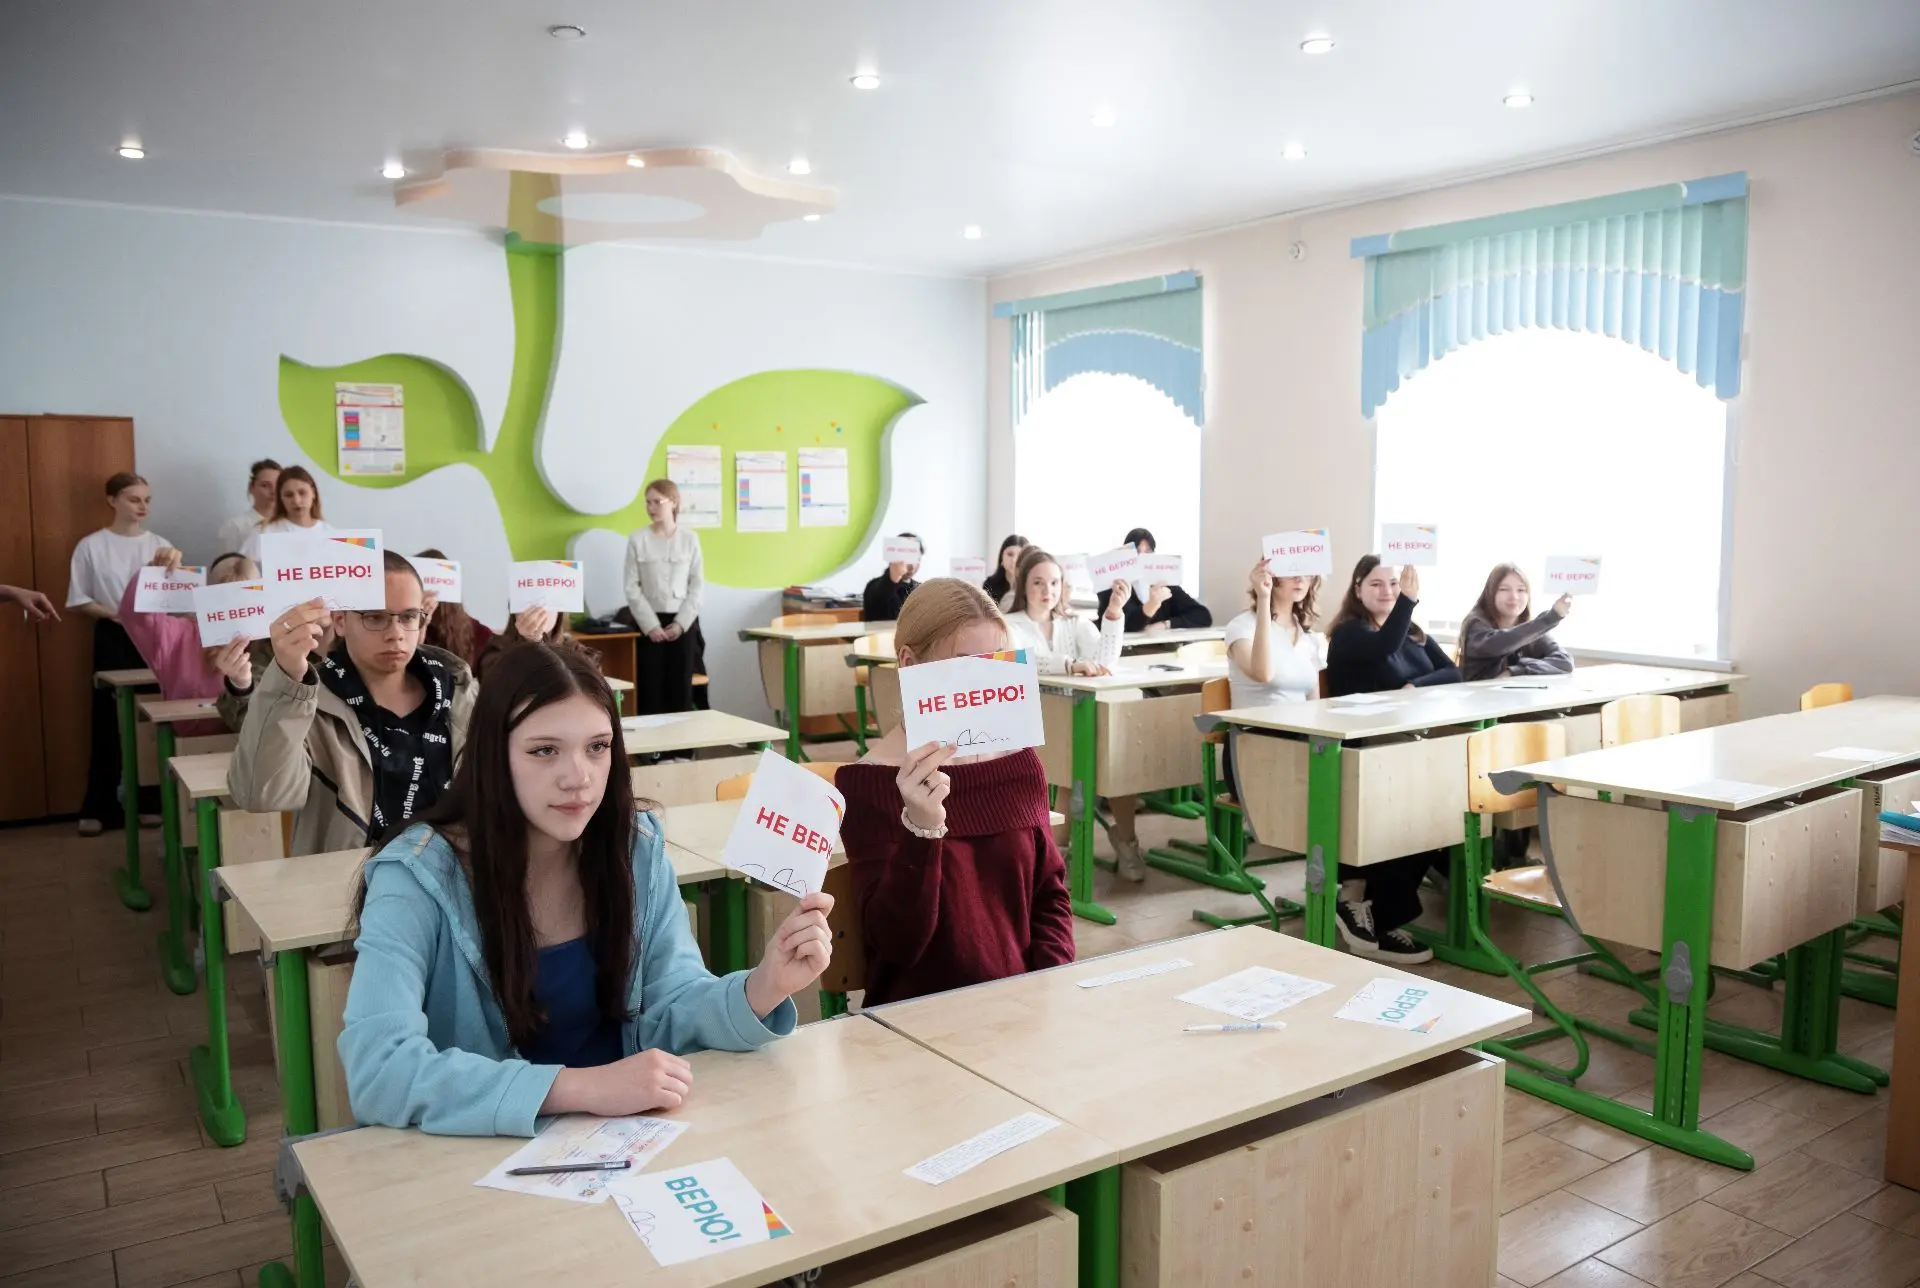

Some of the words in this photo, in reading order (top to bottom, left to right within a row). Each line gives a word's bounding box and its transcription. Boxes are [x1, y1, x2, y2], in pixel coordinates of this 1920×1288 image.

[1271, 547, 1286, 555] НЕ
[1289, 544, 1324, 554] ВЕРЮ!
[277, 567, 303, 581] НЕ
[309, 565, 372, 580] ВЕРЮ!
[144, 582, 159, 591] НЕ
[517, 579, 534, 588] НЕ
[537, 578, 575, 588] ВЕРЮ!
[207, 611, 225, 622] НЕ
[918, 695, 948, 715] НЕ
[953, 684, 1025, 709] ВЕРЮ!
[756, 806, 790, 837] НЕ
[1375, 988, 1429, 1023] ВЕРЮ!
[664, 1176, 742, 1244] ВЕРЮ!
